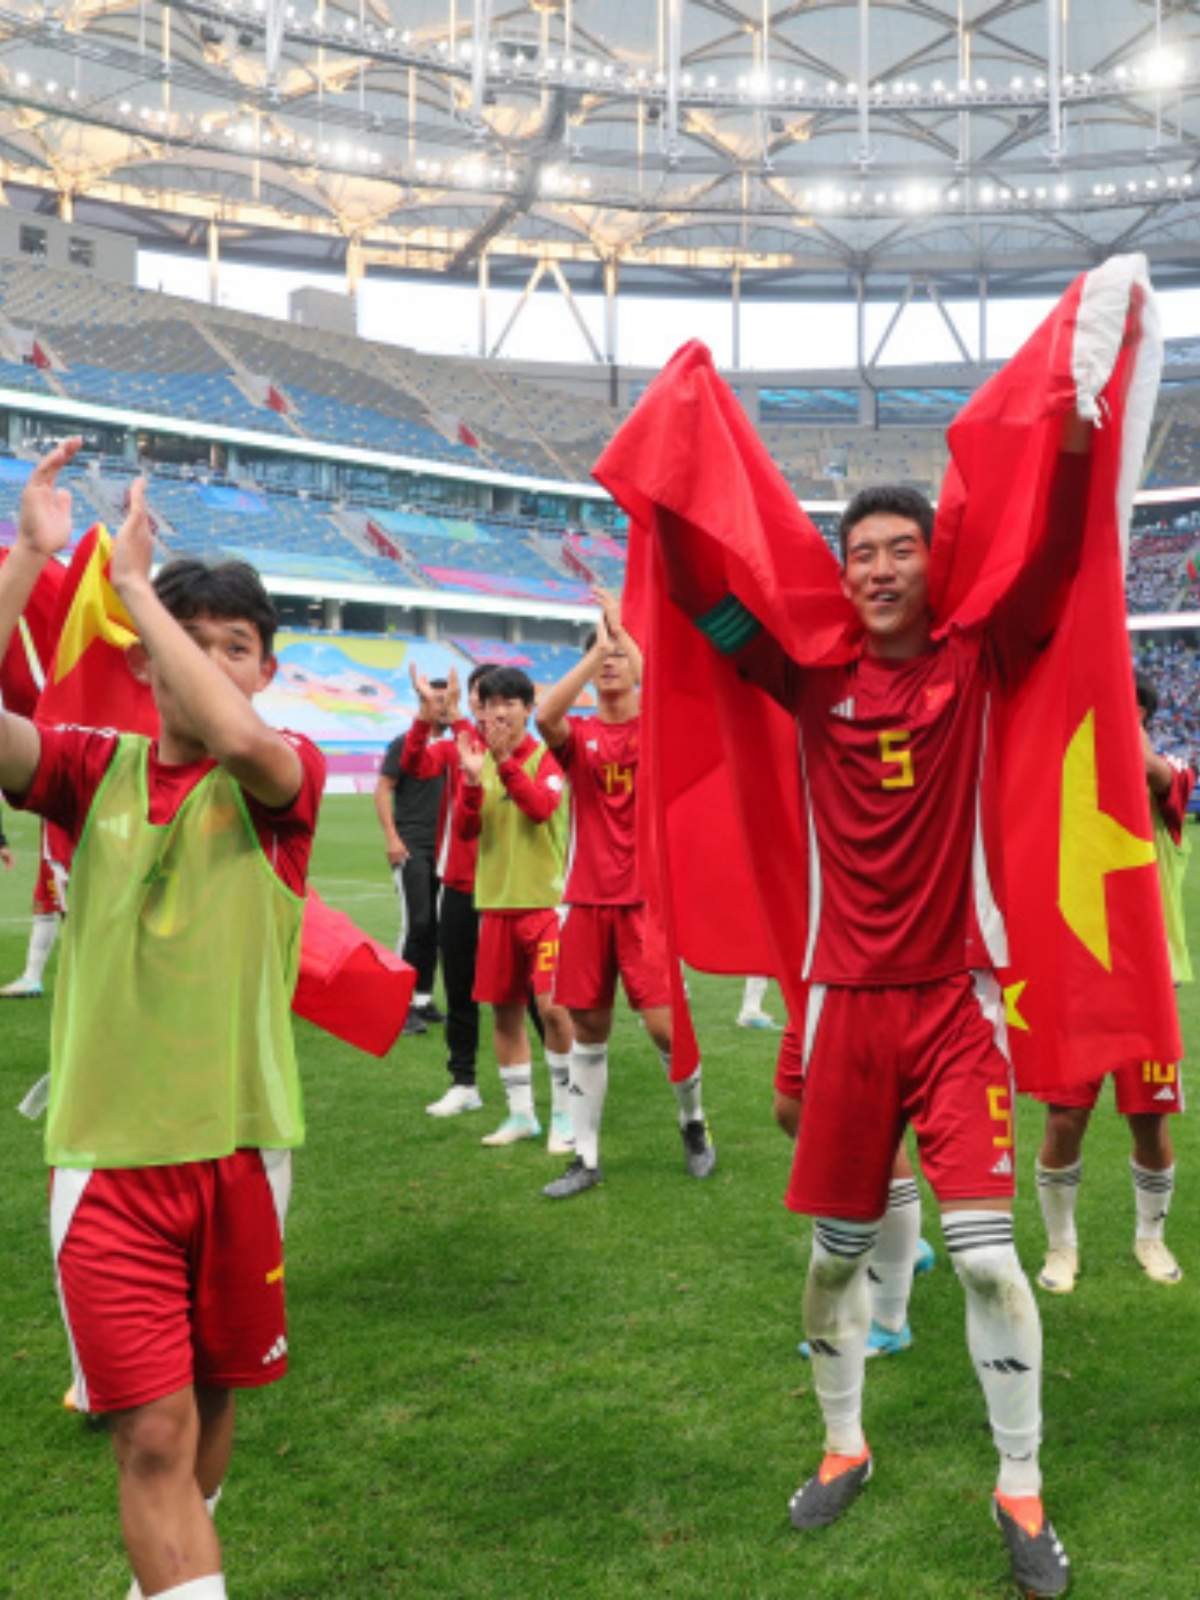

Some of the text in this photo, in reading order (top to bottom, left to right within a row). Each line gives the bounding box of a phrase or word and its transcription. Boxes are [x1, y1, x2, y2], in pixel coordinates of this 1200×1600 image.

[602, 761, 633, 794] 14
[879, 730, 914, 789] 5
[986, 1086, 1013, 1148] 5
